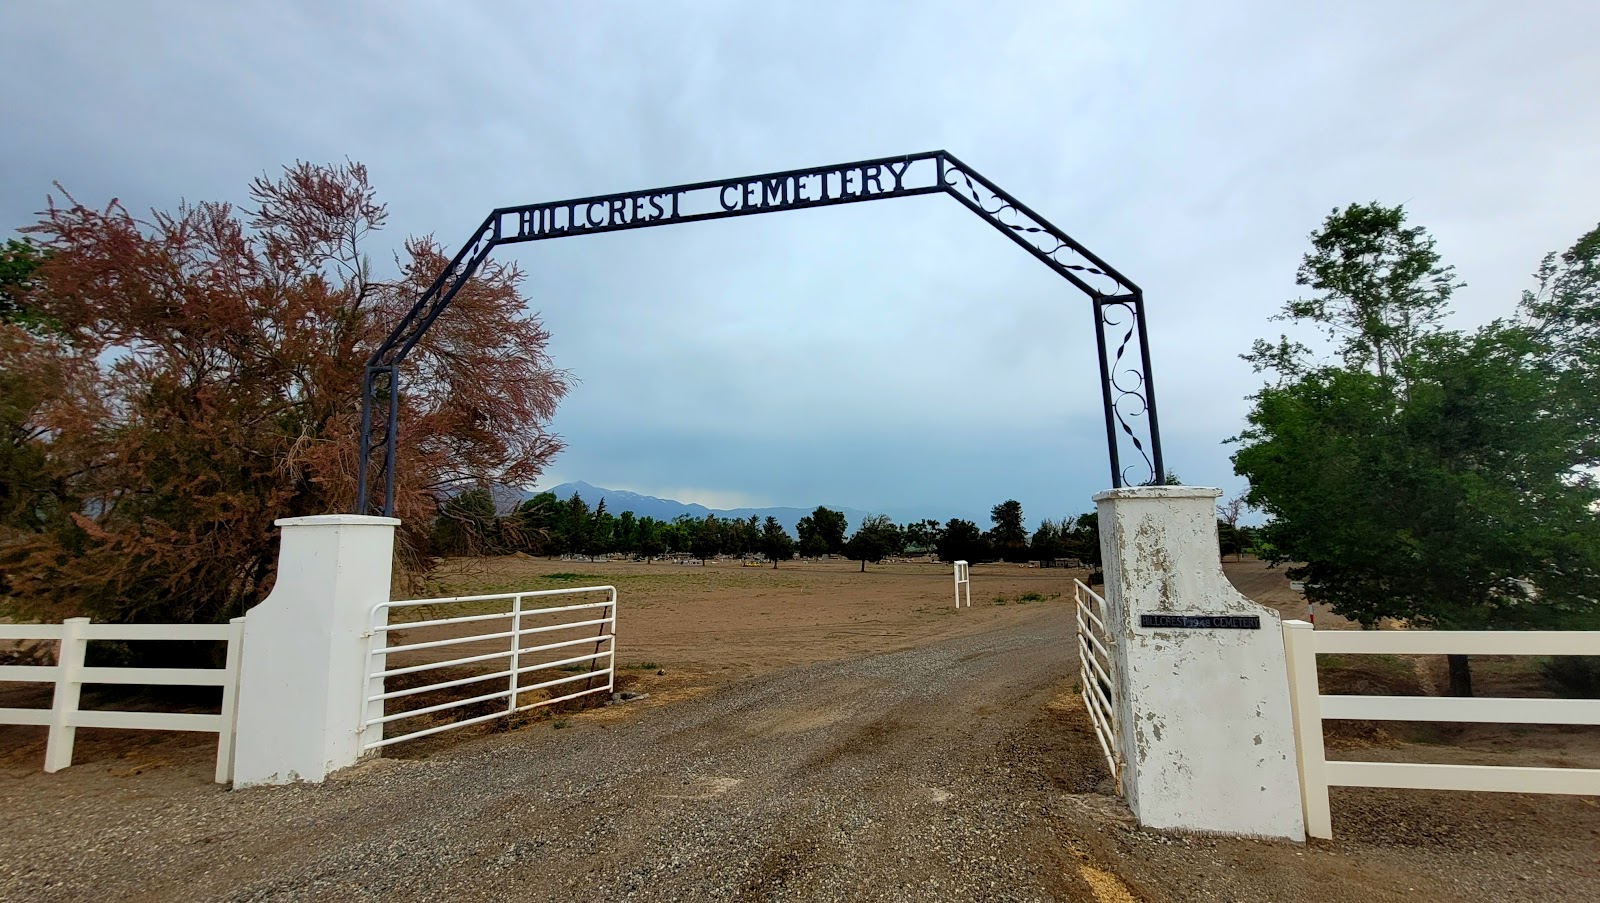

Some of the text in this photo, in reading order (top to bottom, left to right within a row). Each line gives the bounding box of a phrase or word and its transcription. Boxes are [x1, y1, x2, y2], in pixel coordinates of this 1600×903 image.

[518, 162, 913, 237] HILLCREST CEMETERY
[1142, 616, 1187, 627] HILLCREST
[1213, 618, 1259, 628] CEMETERY
